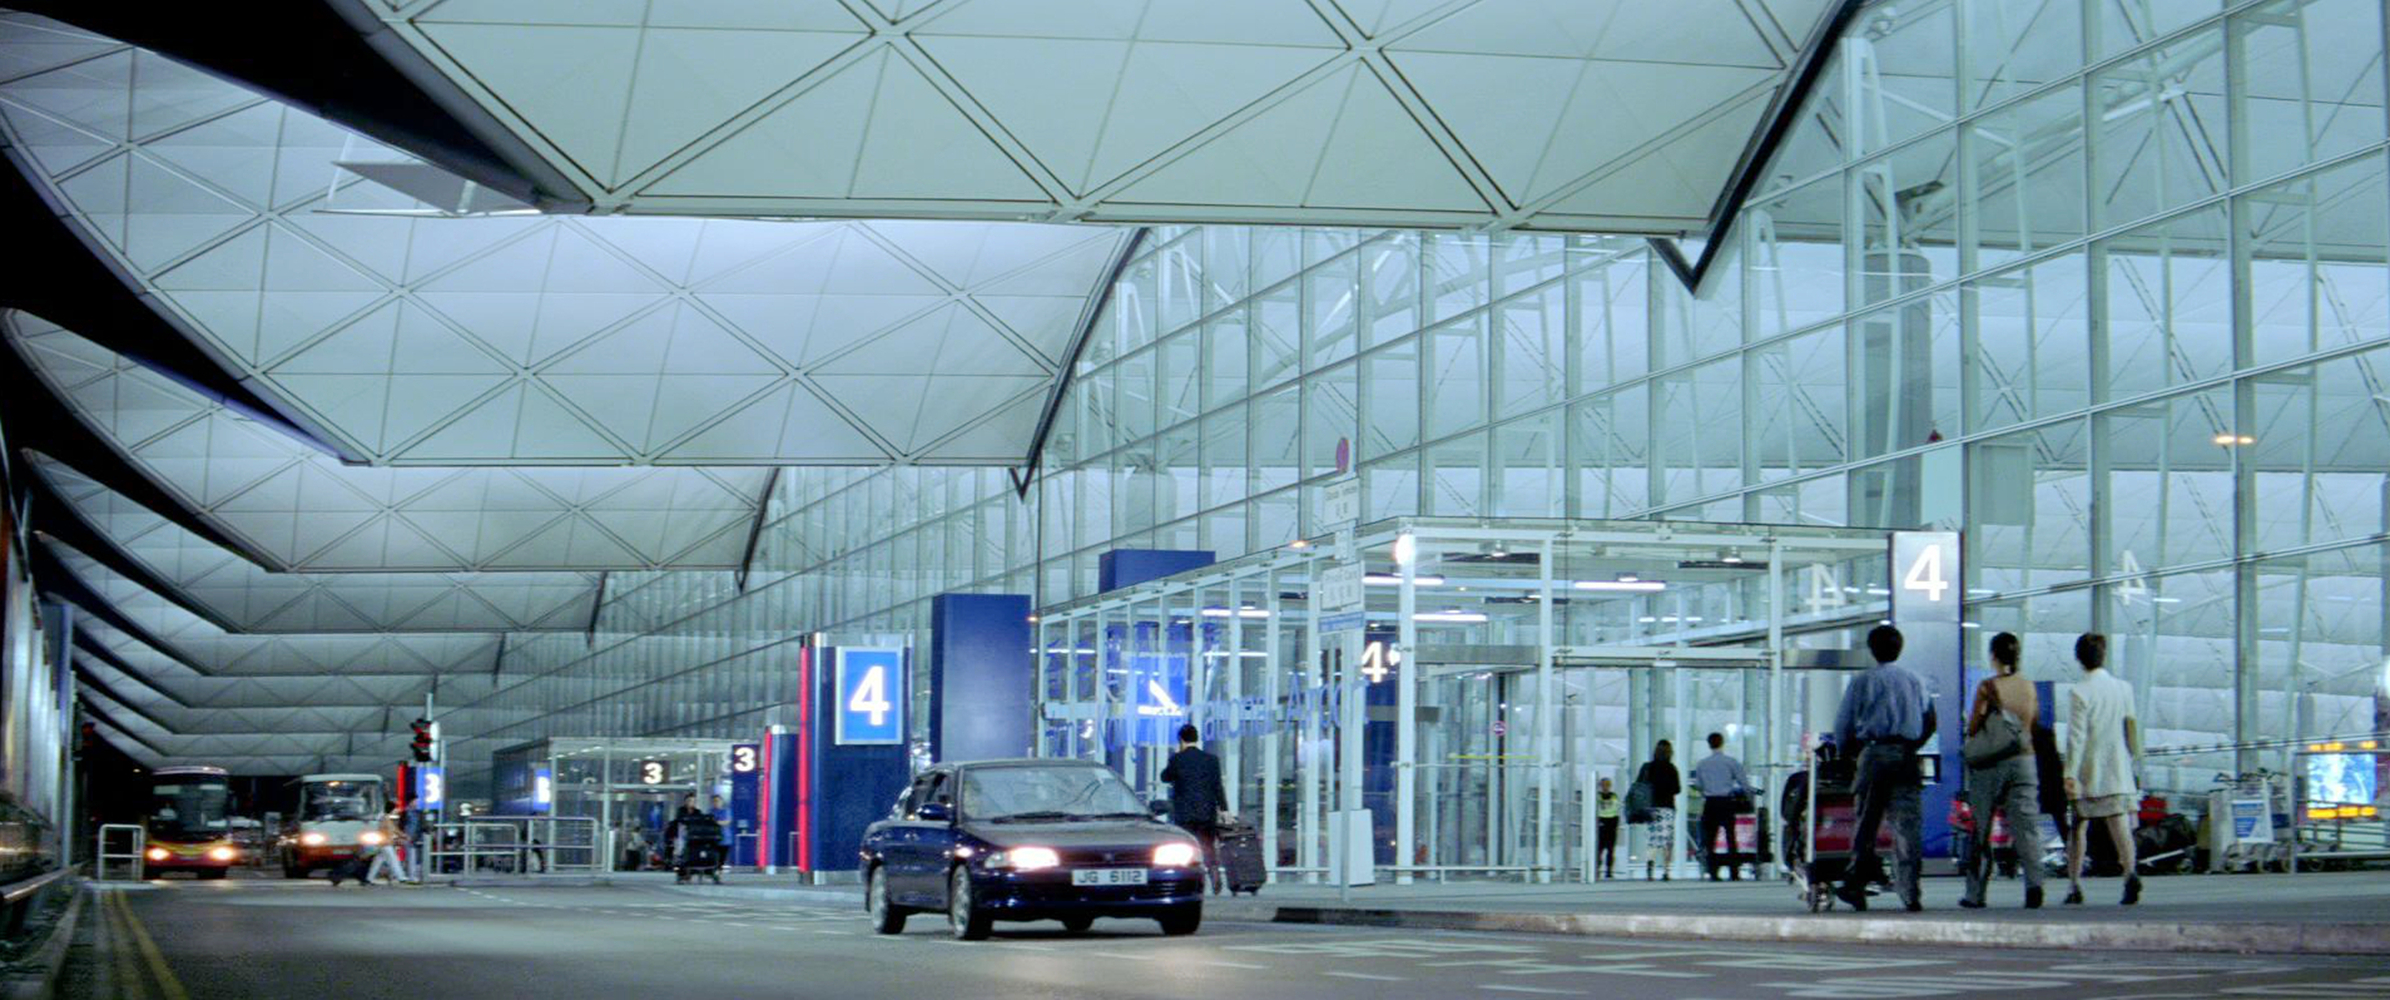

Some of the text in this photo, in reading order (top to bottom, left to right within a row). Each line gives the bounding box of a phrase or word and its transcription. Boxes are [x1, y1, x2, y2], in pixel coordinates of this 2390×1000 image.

[1903, 544, 1948, 601] 4
[1361, 641, 1388, 683] 4
[850, 665, 890, 726] 4
[643, 762, 663, 785] 3
[734, 746, 755, 772] 3
[425, 773, 440, 803] 3
[1078, 870, 1142, 883] JG 6112
